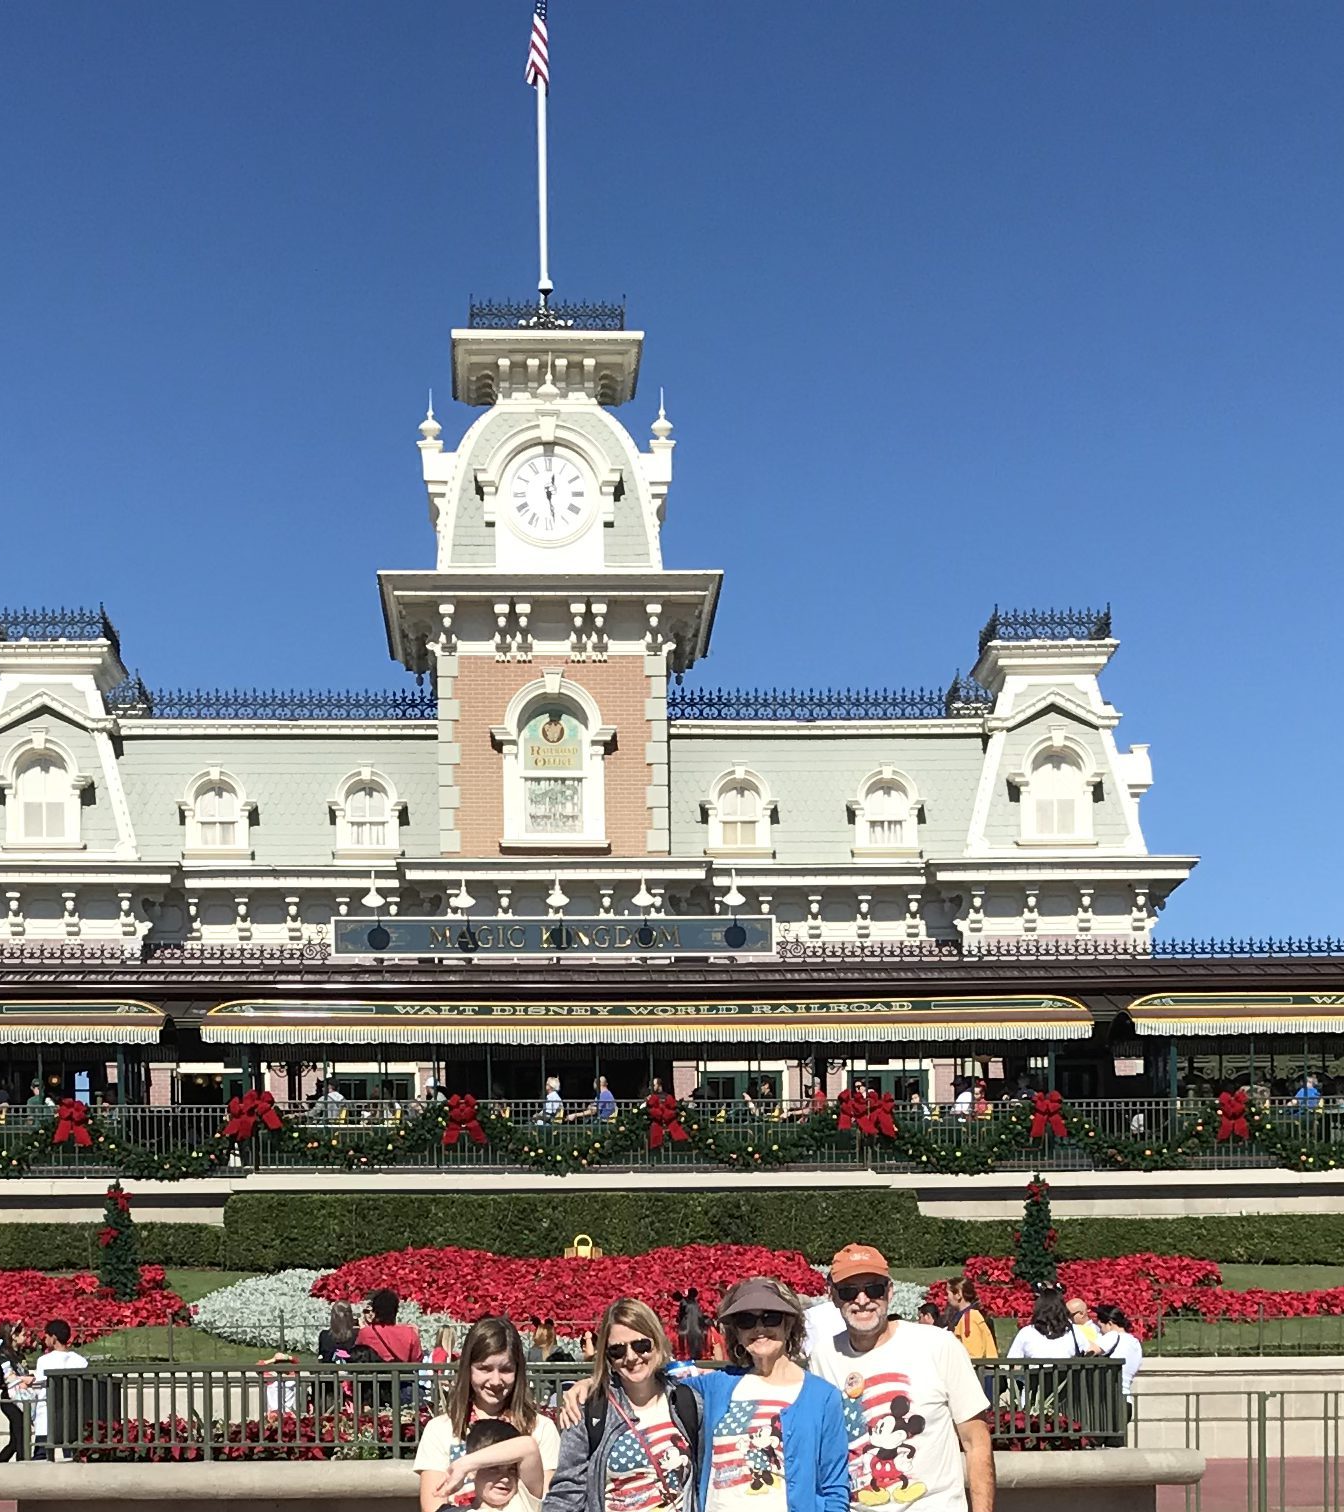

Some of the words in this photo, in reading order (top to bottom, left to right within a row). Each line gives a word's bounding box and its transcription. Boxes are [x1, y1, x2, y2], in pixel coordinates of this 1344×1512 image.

[430, 926, 525, 948] MAGIC
[539, 926, 681, 948] KINGDOM
[394, 1006, 478, 1015] WALT
[491, 1006, 613, 1015] DISNEY
[626, 1005, 739, 1015] WORLD
[751, 1002, 913, 1014] RAILROAD
